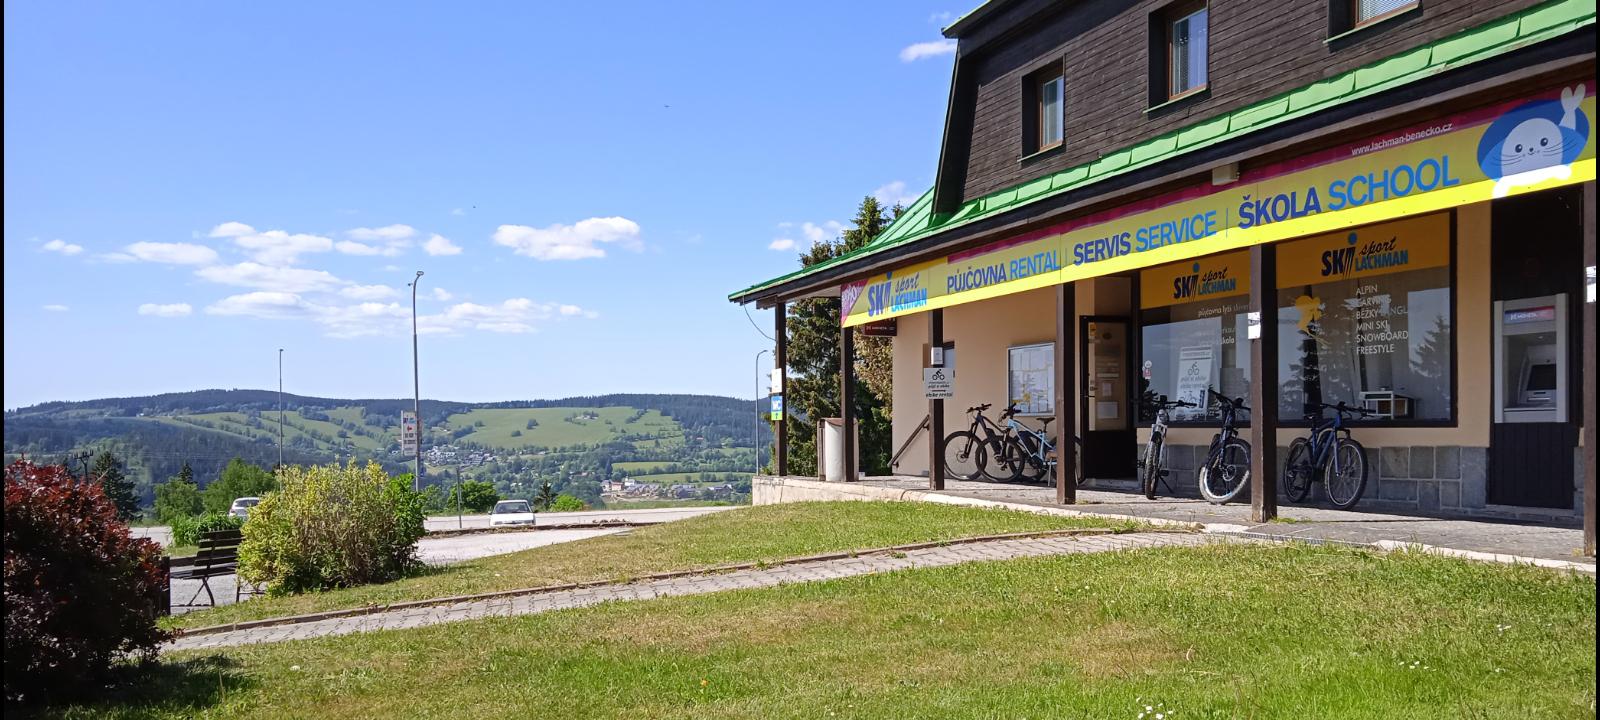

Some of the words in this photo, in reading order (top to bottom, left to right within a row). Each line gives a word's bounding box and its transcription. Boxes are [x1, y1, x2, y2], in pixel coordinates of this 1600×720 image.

[1351, 123, 1453, 156] www.lachman-benecko.cz
[1009, 250, 1060, 280] RENTAL
[1073, 231, 1131, 266] SERVIS
[1135, 209, 1217, 253] SERVICE
[1238, 186, 1322, 230] ŠKOLA
[1328, 155, 1460, 212] SCHOOL
[1355, 250, 1409, 272] LACHMAN
[1198, 277, 1236, 296] LACHMAN
[1356, 284, 1378, 295] ALPIN
[1356, 321, 1374, 331] MINI
[1376, 320, 1388, 329] SKI
[1356, 330, 1409, 343] SNOWBOARD
[1356, 344, 1395, 355] FREESTYLE
